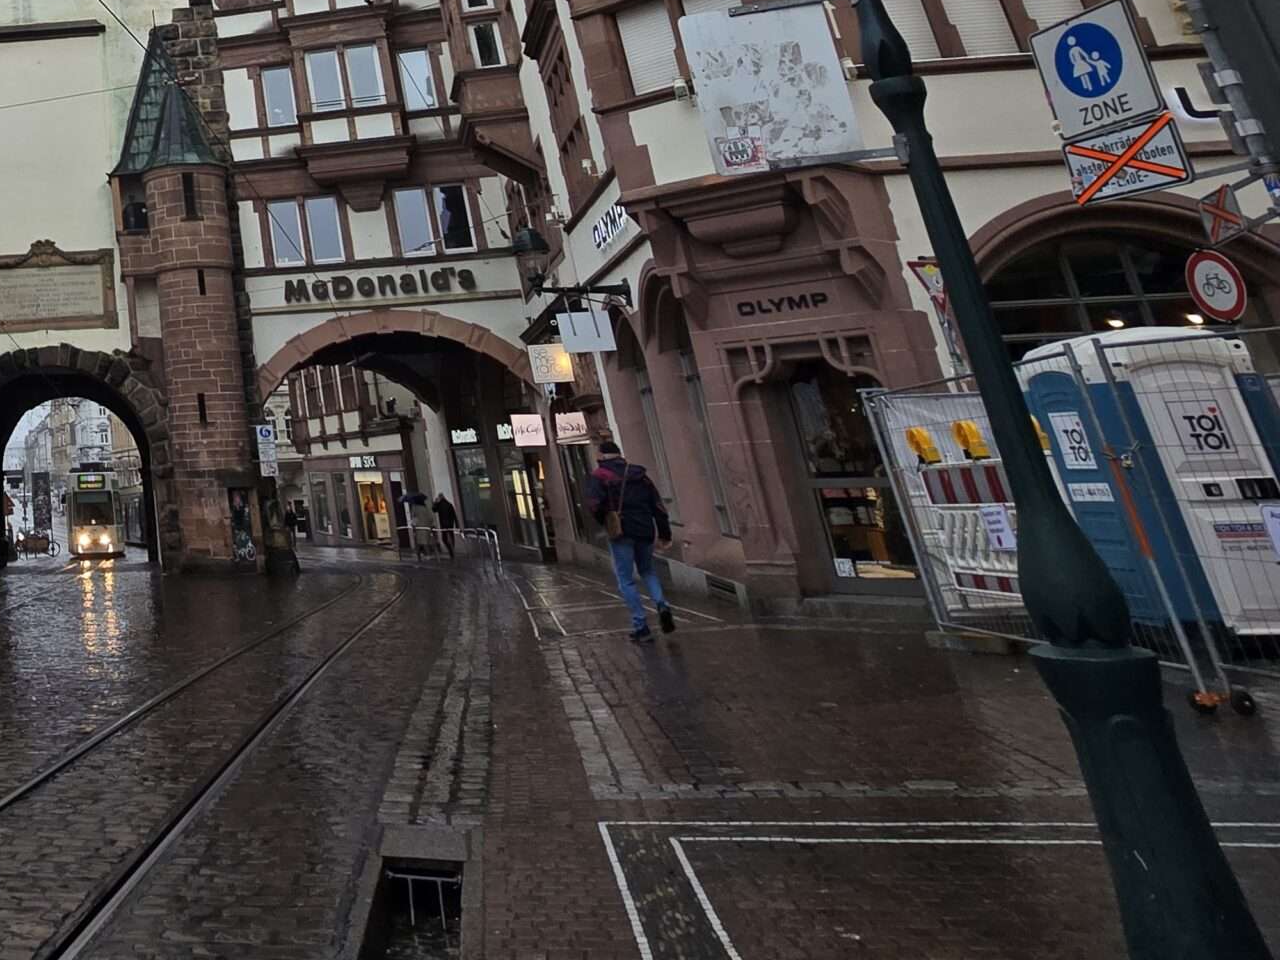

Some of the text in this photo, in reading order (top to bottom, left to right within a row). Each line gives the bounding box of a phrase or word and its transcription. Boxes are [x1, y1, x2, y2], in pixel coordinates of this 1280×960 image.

[1078, 93, 1133, 126] ZONE
[592, 205, 624, 249] OLYMP
[284, 267, 477, 304] McDonald's
[737, 292, 828, 317] OLYMP
[1190, 432, 1231, 451] TOI
